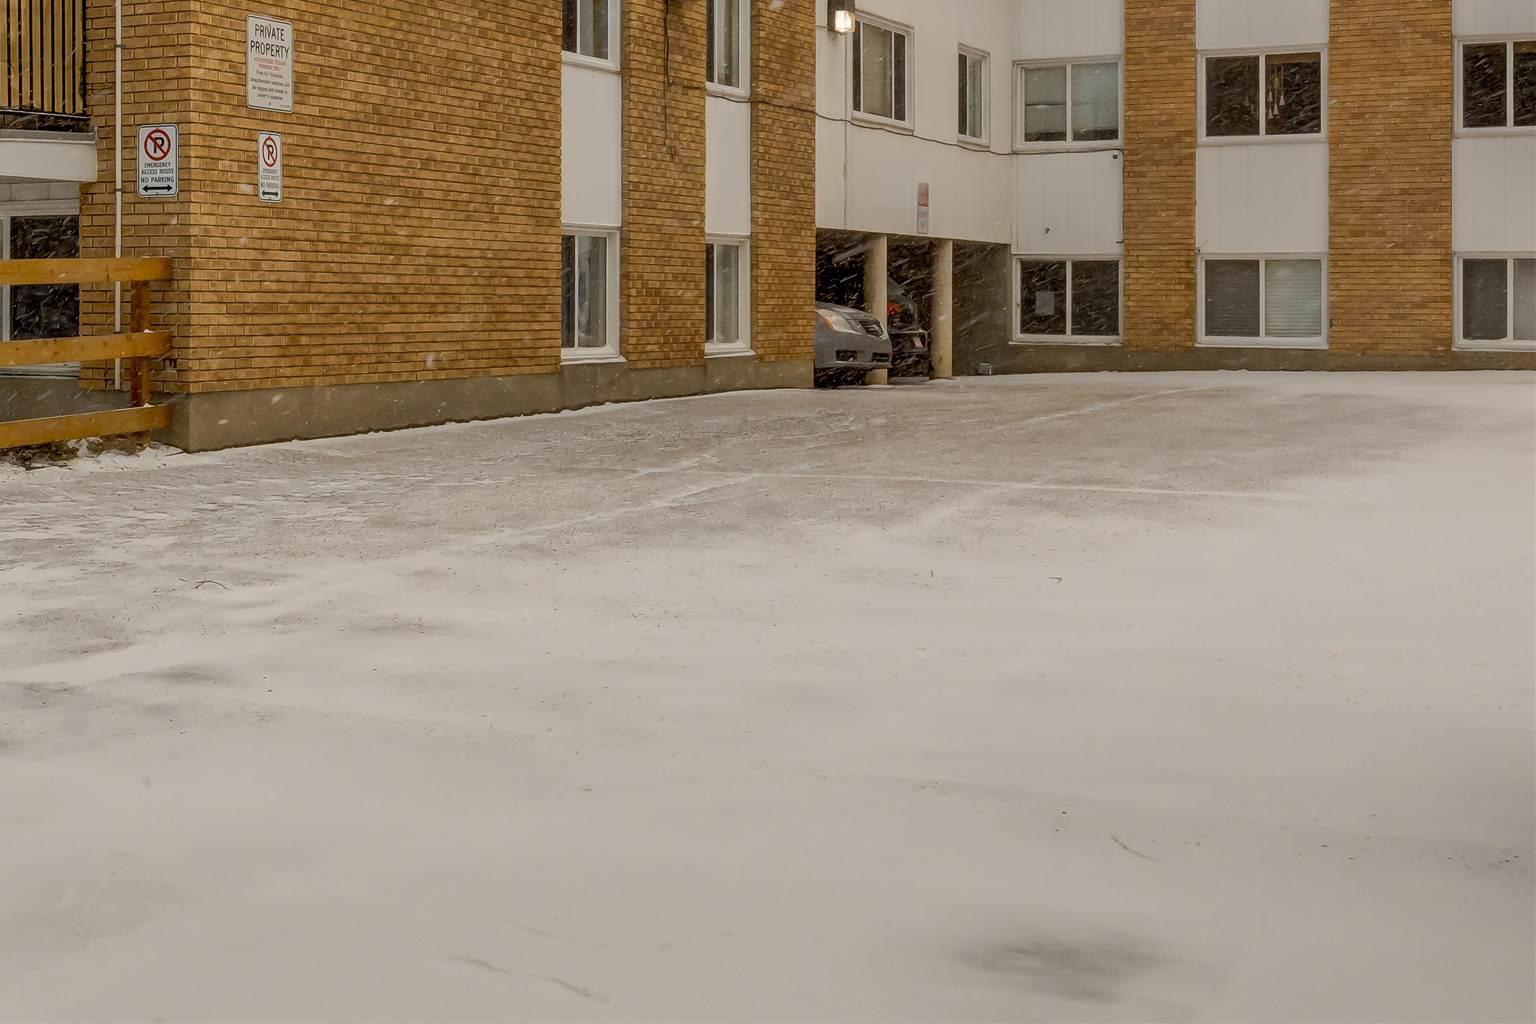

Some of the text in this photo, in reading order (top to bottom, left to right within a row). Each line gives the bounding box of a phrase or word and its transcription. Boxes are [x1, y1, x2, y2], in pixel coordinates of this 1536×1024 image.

[254, 23, 285, 42] PRIVATE
[250, 39, 290, 59] PROPERTY
[140, 175, 175, 184] NO PARKING
